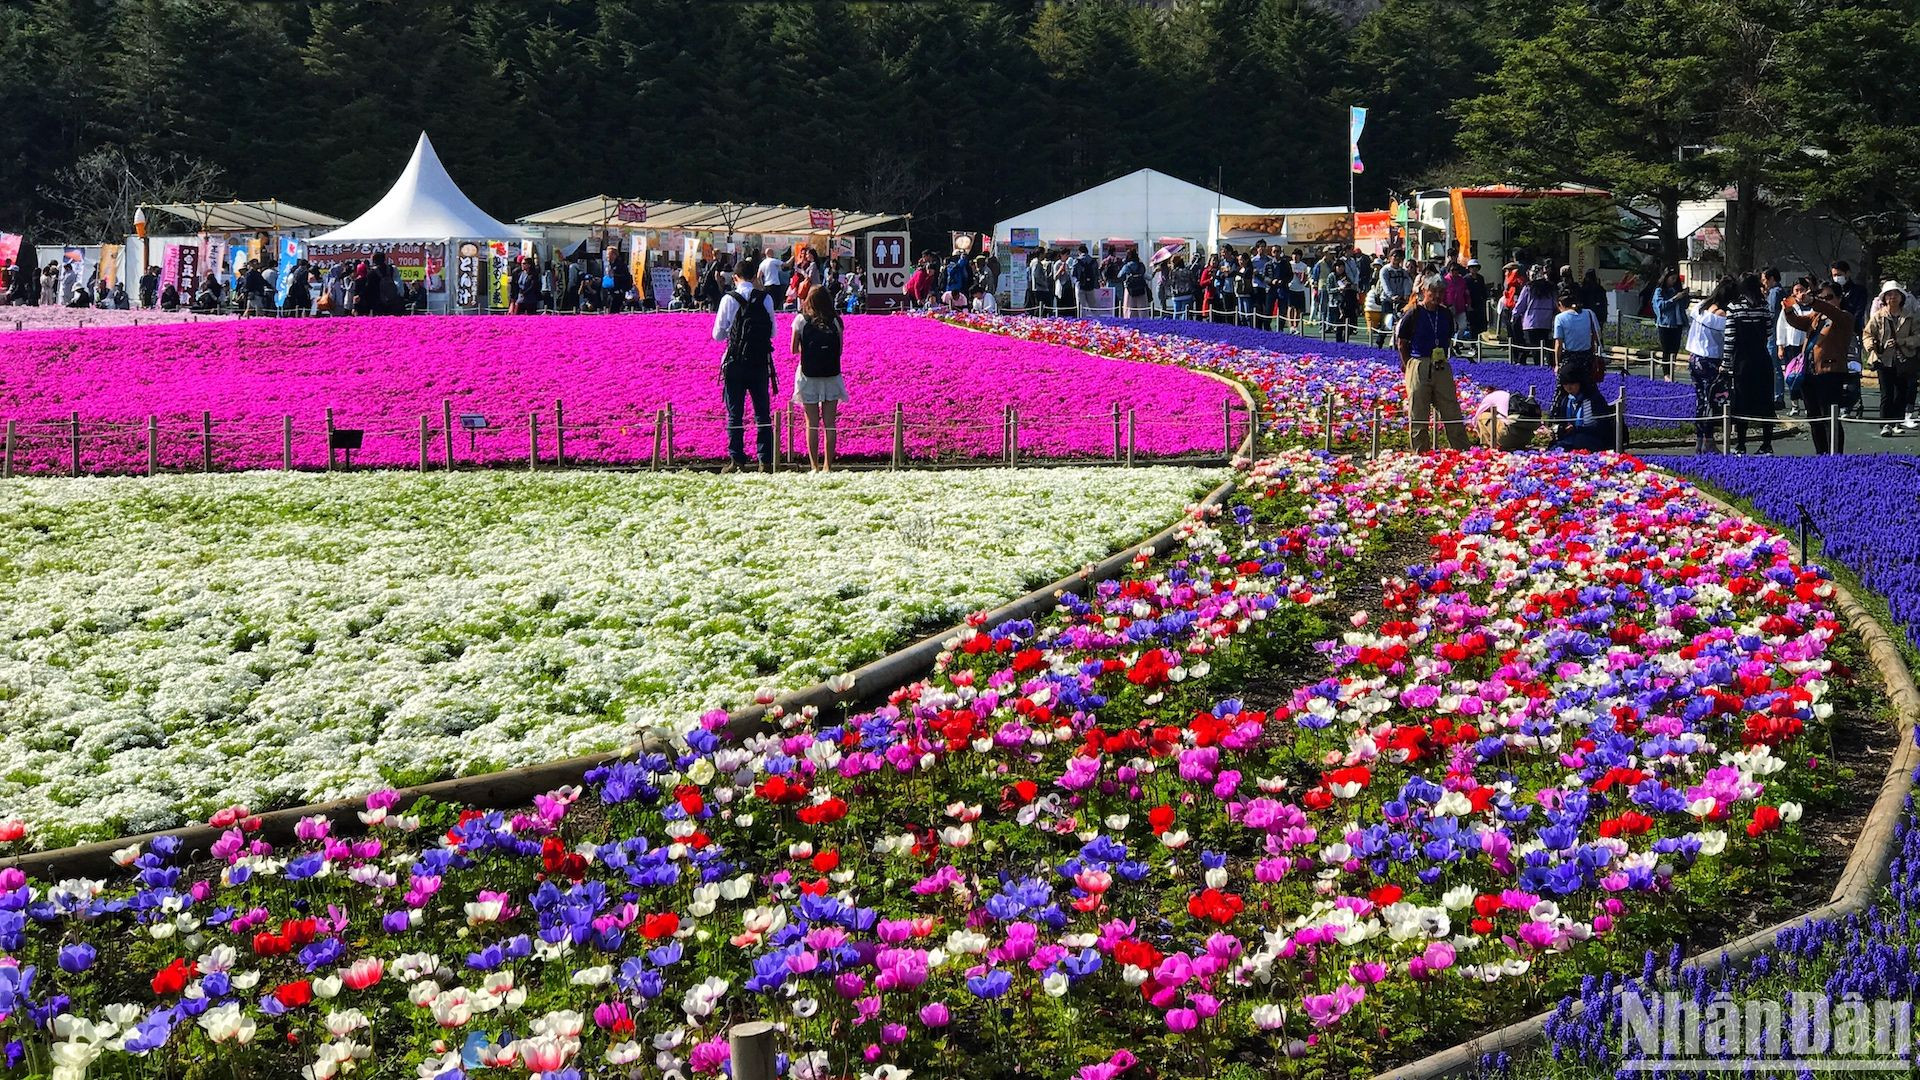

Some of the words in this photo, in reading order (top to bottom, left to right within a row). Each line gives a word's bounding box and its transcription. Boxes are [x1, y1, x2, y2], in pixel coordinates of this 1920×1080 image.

[459, 256, 471, 305] とん汁
[872, 272, 905, 288] WC
